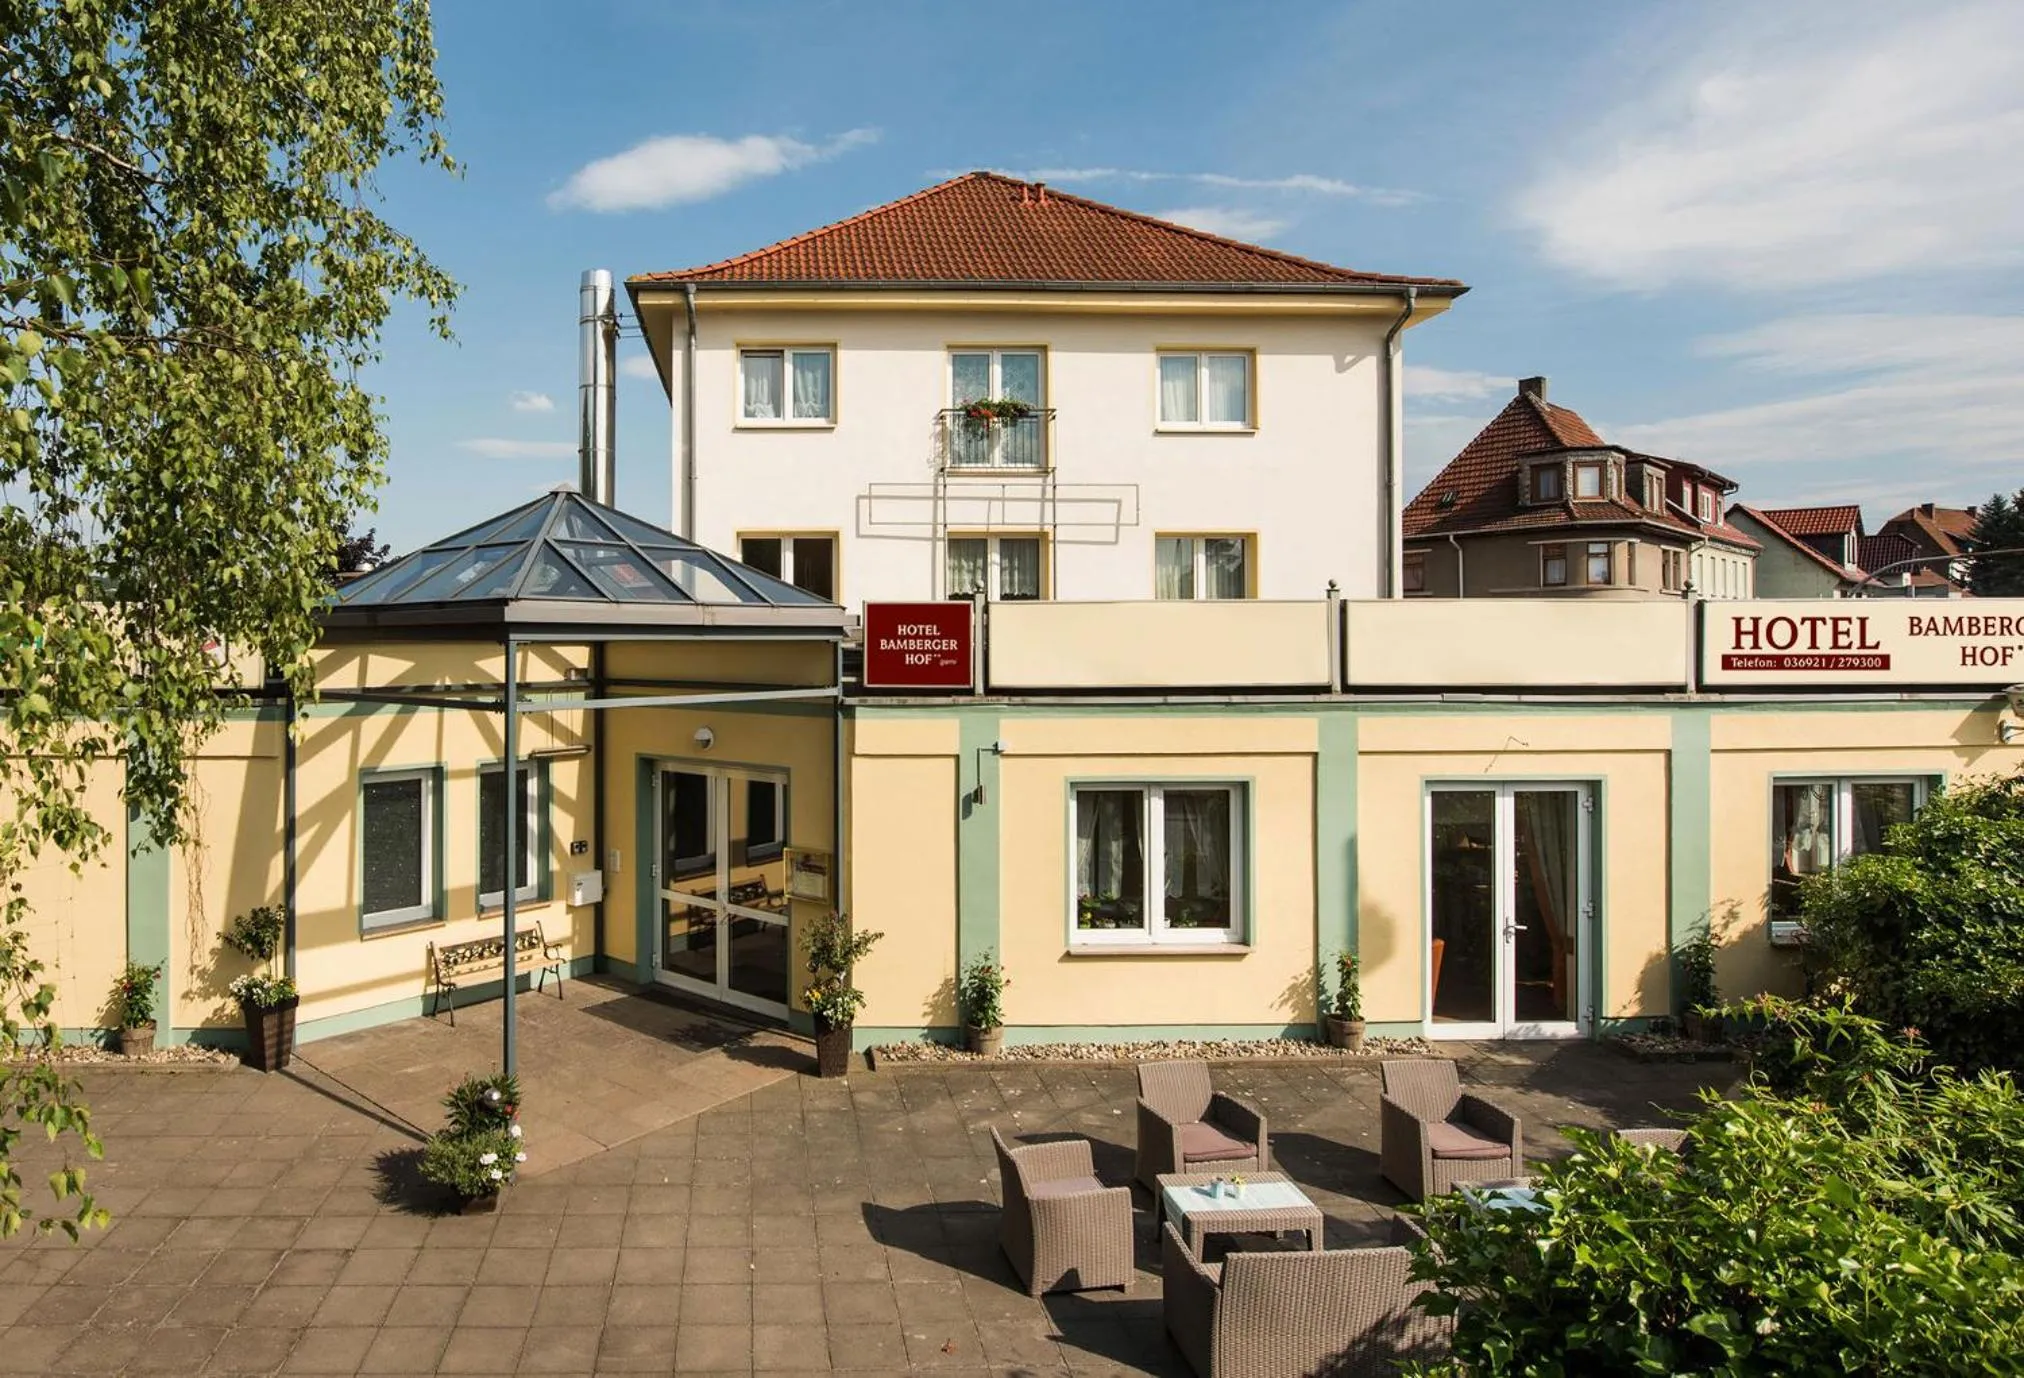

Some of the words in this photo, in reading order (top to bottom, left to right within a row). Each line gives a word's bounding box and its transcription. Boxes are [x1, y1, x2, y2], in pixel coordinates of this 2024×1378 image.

[897, 624, 941, 636] HOTEL
[1731, 616, 1880, 650] HOTEL
[880, 639, 958, 650] BAMBERGER
[904, 653, 932, 665] HOF
[1960, 646, 2014, 666] HOF
[1731, 657, 1777, 668] Telefon:
